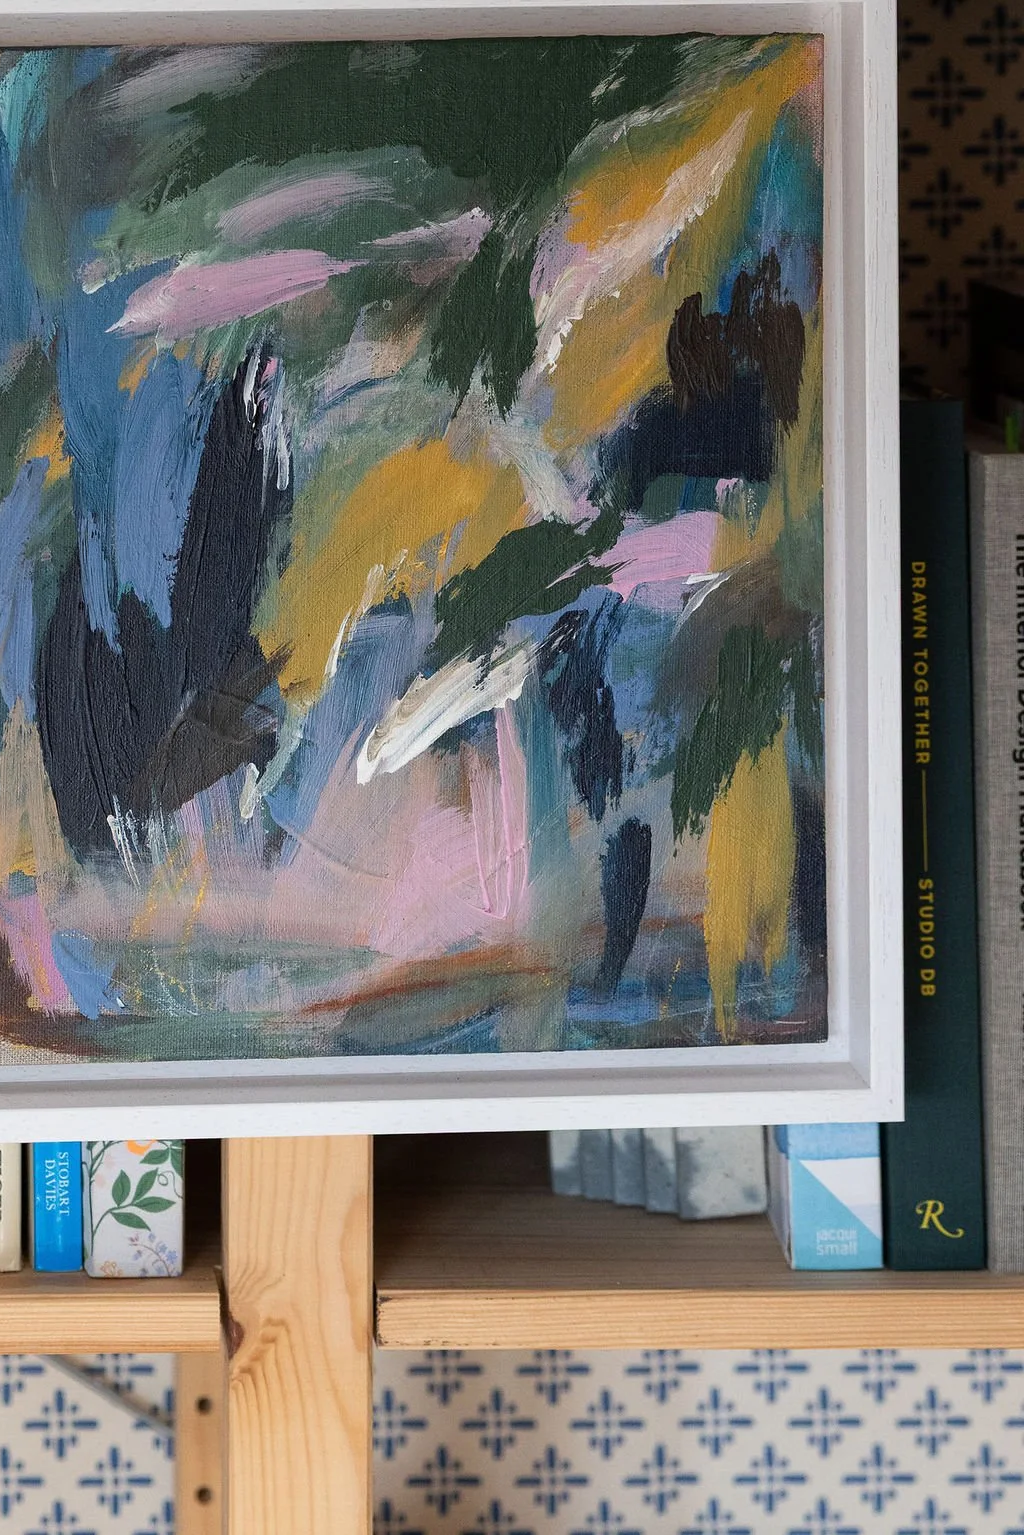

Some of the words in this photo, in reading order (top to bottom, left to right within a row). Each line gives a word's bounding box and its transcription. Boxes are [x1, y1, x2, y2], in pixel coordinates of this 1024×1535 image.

[911, 561, 928, 639] DRAWN
[913, 649, 930, 764] TOGETHER
[918, 878, 935, 960] STUDIO
[920, 968, 936, 996] DB
[45, 1159, 56, 1212] DAVIES
[57, 1151, 70, 1217] STOBART
[816, 1241, 858, 1256] small
[915, 1199, 965, 1239] R
